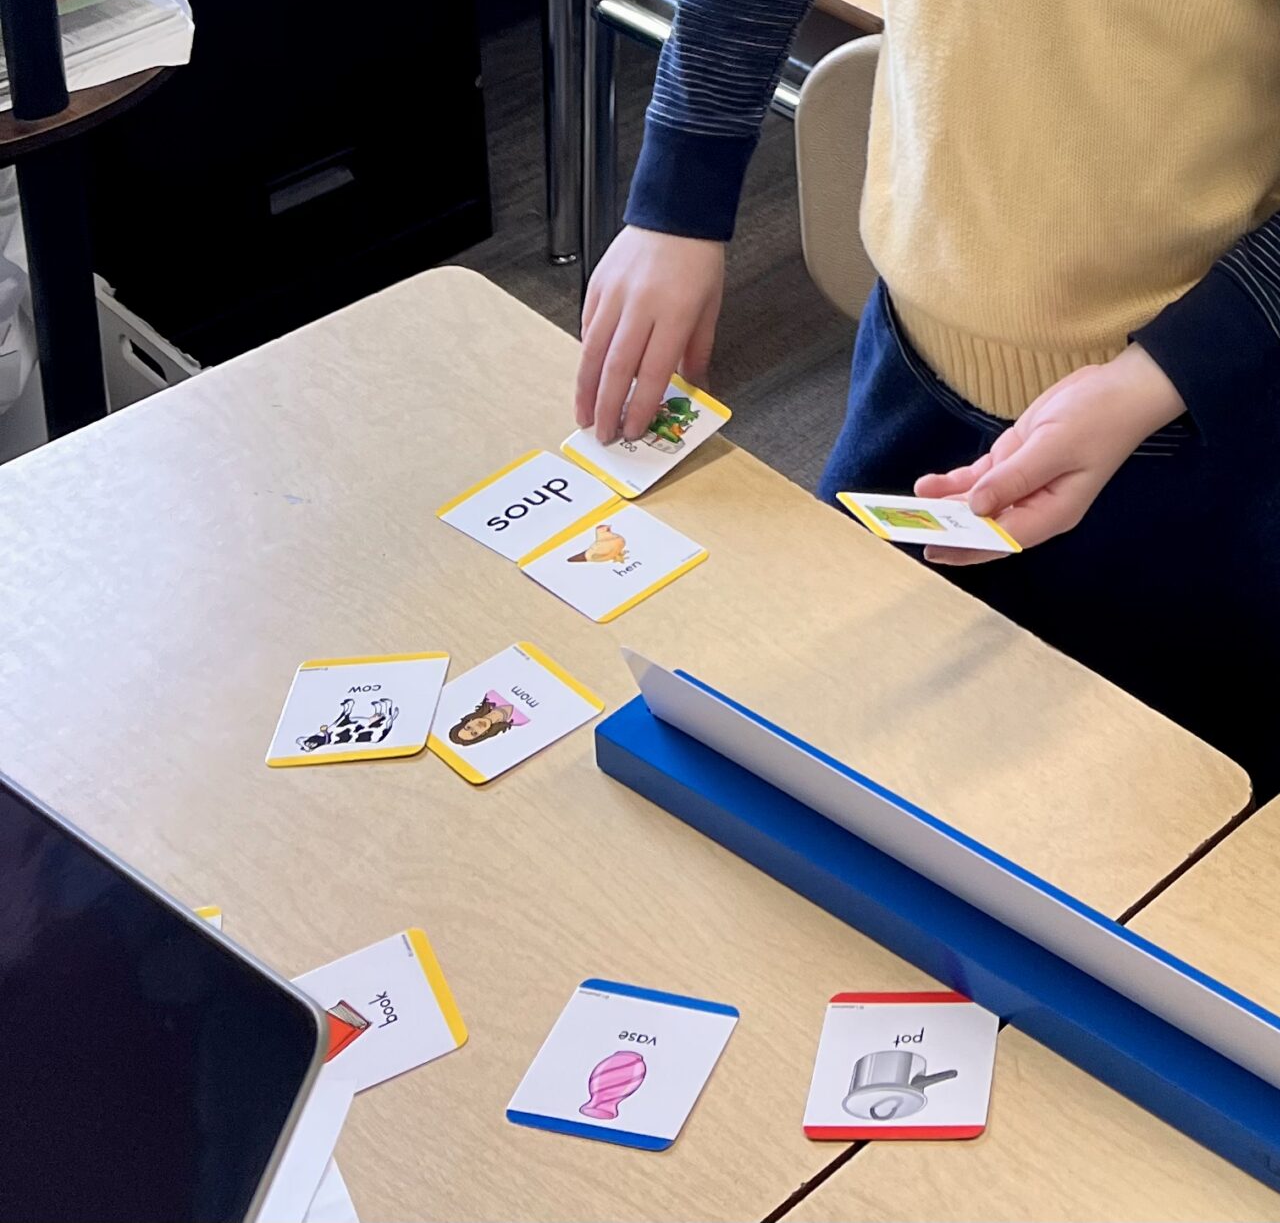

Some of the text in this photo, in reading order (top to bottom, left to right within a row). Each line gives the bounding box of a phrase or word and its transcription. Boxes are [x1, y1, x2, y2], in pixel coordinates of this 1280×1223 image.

[620, 439, 638, 453] zoo
[486, 478, 573, 532] soup
[612, 559, 643, 578] hen
[348, 684, 381, 694] cow
[511, 684, 540, 709] mom
[368, 990, 398, 1029] book
[618, 1030, 657, 1046] vase
[893, 1027, 925, 1048] pot
